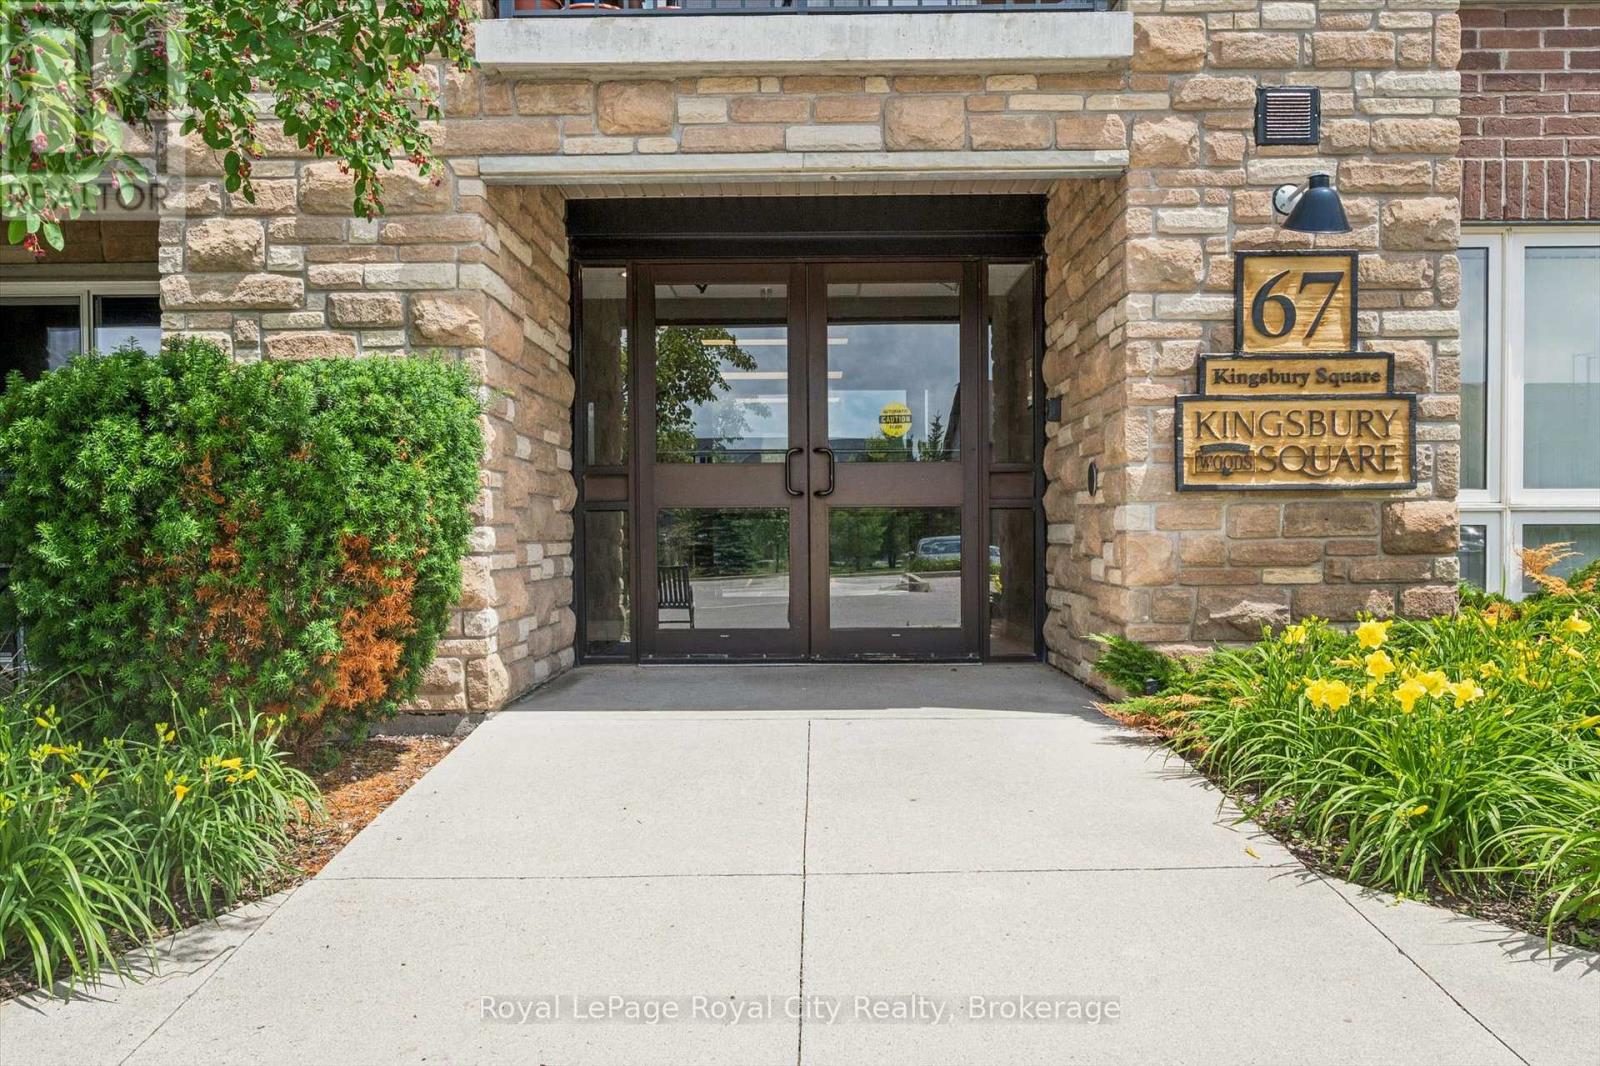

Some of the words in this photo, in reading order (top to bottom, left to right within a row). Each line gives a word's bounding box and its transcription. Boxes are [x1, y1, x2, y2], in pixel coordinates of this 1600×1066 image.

[1251, 269, 1345, 341] 67
[1213, 368, 1310, 388] Kingsbury
[1315, 367, 1381, 388] Square
[1195, 410, 1398, 440] KINGSBURY
[1197, 454, 1253, 471] WOODS
[1257, 444, 1399, 477] SQUARE
